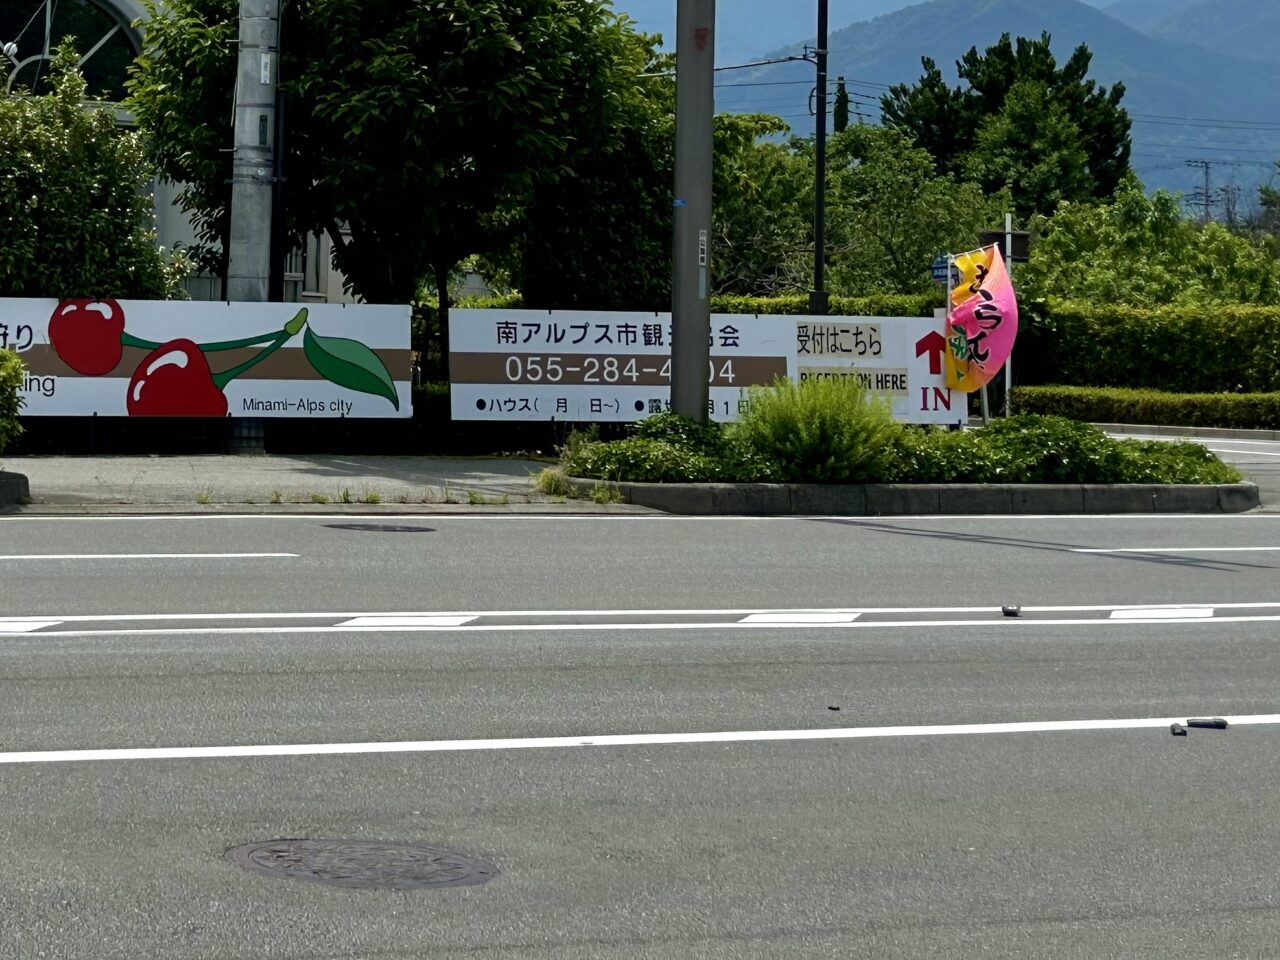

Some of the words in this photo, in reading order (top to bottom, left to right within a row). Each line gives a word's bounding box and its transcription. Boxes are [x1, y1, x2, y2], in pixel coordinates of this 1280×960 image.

[496, 321, 740, 348] 南アルプス市観会
[797, 325, 882, 356] 受付はこちら
[505, 356, 736, 384] 055-284-44
[876, 374, 907, 390] HERE
[242, 398, 325, 414] Minami-Alps
[329, 399, 353, 415] city
[920, 386, 951, 411] IN
